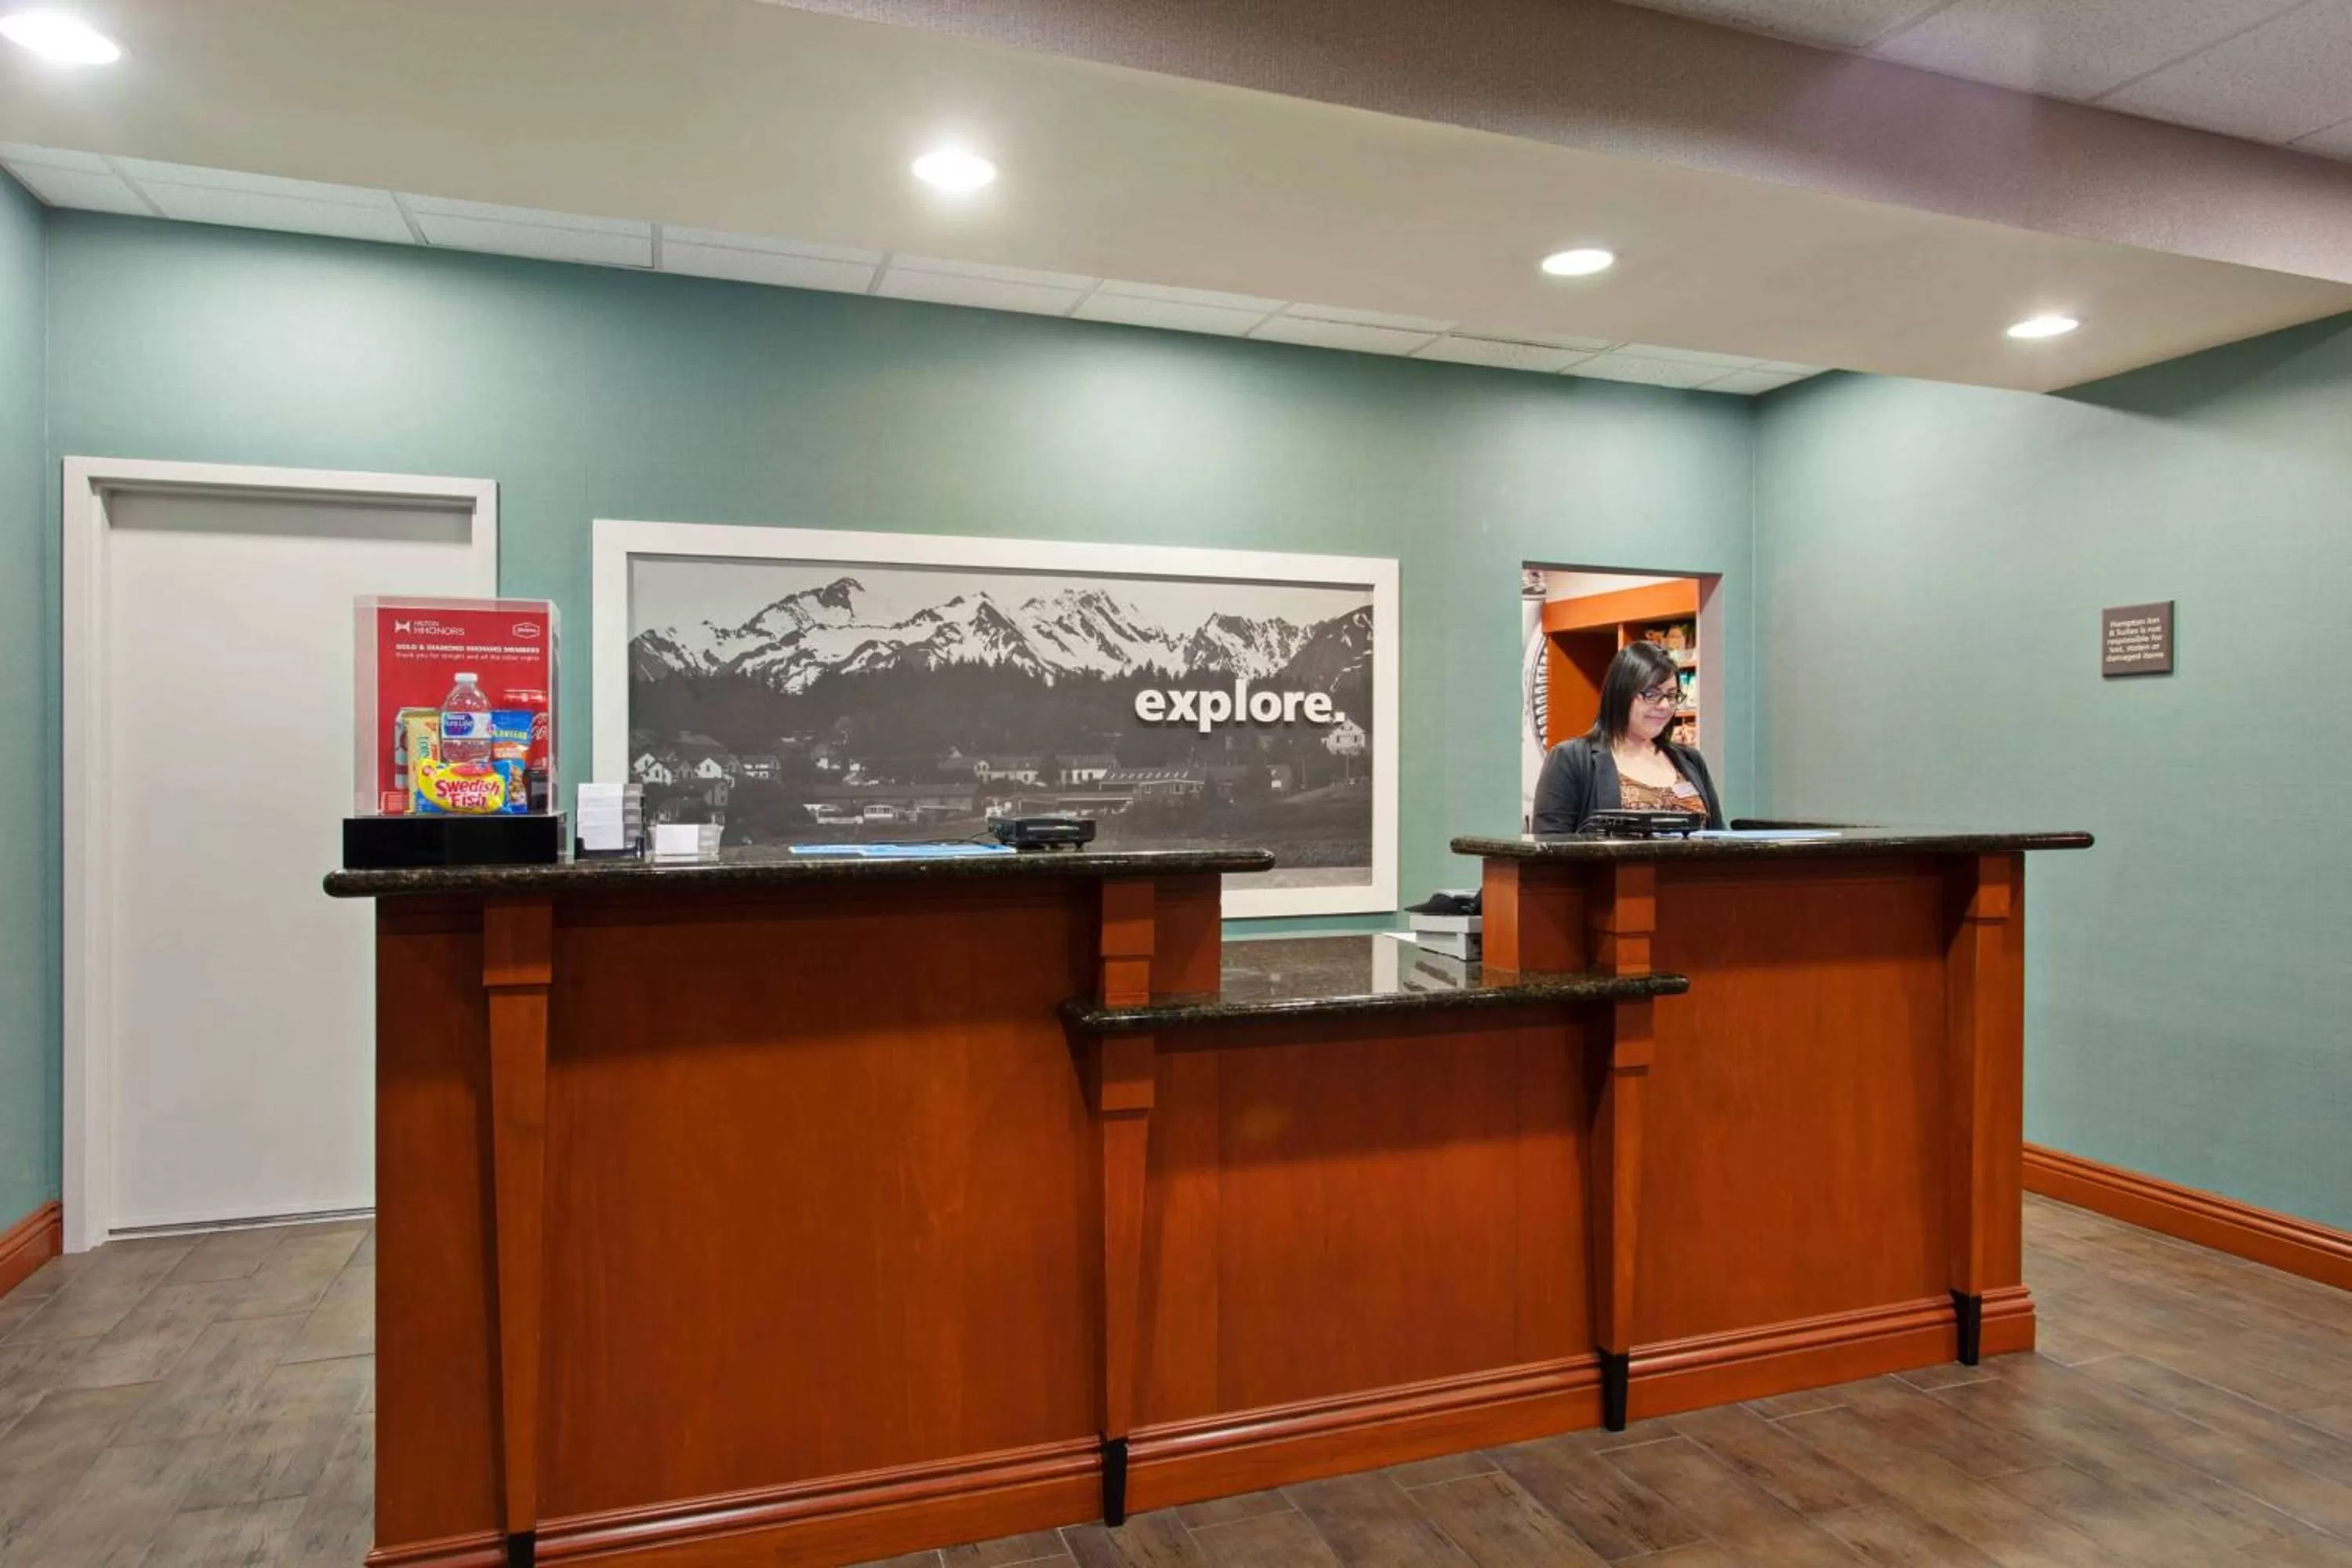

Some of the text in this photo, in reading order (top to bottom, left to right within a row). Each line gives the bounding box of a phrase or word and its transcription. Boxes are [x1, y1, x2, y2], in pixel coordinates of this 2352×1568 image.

[413, 626, 465, 636] HHONORS
[1134, 678, 1346, 733] explore.
[434, 779, 500, 797] Swedish
[449, 793, 487, 808] Fish
